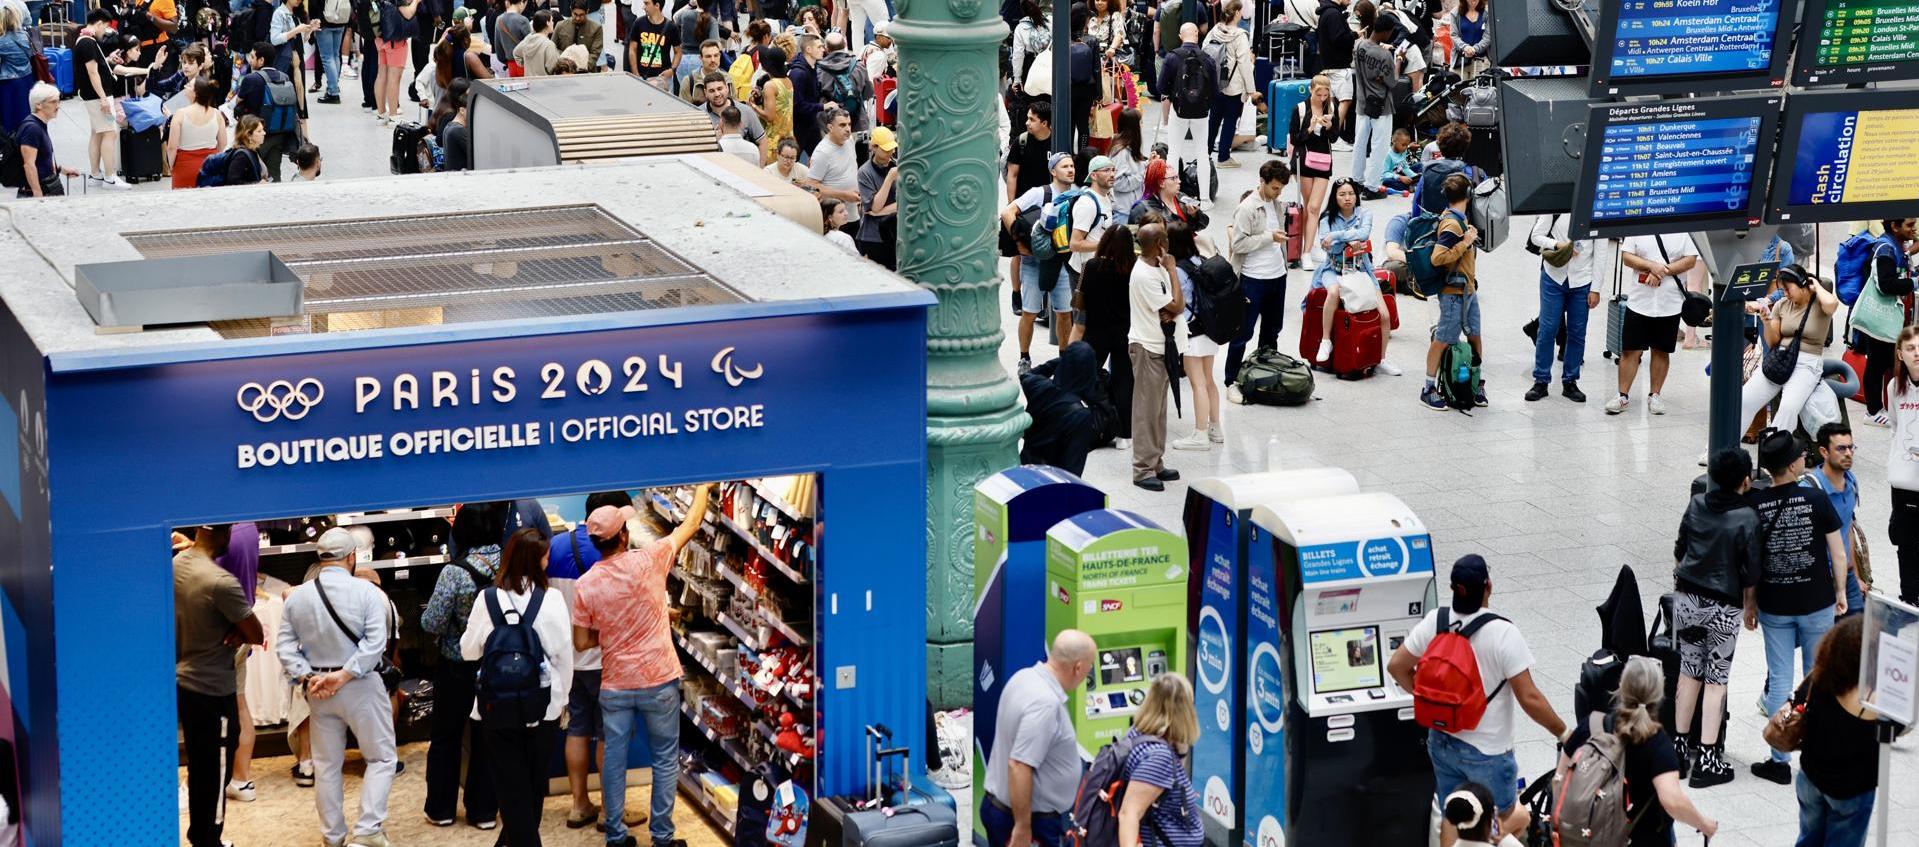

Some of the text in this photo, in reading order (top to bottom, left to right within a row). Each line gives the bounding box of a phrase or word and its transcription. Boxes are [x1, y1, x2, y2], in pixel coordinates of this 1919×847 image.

[1877, 7, 1906, 15] Bruxelles
[1673, 17, 1722, 26] Amsterdam
[1724, 15, 1760, 24] Centraal
[1875, 16, 1904, 25] Bruxelles
[1686, 26, 1716, 34] Bruxelles
[1718, 25, 1734, 33] Midi
[1873, 26, 1898, 34] London
[1648, 38, 1668, 46] 10h24
[1670, 35, 1719, 45] Amsterdam
[1721, 33, 1757, 42] Centraal
[1871, 35, 1891, 43] Calais
[1892, 33, 1907, 41] Ville
[1647, 46, 1684, 56] Antwerpen
[1685, 44, 1714, 53] Centraal
[1870, 43, 1899, 52] Bruxelles
[1900, 41, 1915, 50] Midi
[1667, 55, 1692, 63] Calais
[1694, 53, 1713, 62] Ville
[1868, 52, 1905, 61] Amsterdam
[1609, 103, 1695, 117] Départs Grandes Lignes
[1660, 123, 1696, 133] Dunkerque
[1658, 132, 1702, 142] Valenciennes
[1656, 142, 1685, 150] Beauvais
[1655, 147, 1733, 160] Saint-Just-en-Chaussée
[1653, 157, 1704, 170] Enregistrement
[1705, 156, 1727, 165] ouvert
[1828, 115, 1856, 204] circulation
[1651, 170, 1677, 178] Amiens
[1724, 130, 1751, 210] départs
[1650, 180, 1667, 188] Laon
[1811, 164, 1831, 205] flash
[1649, 188, 1679, 197] Bruxelles
[1680, 186, 1696, 195] Midi
[1667, 195, 1681, 204] Hbf
[1646, 206, 1675, 215] Beauvais
[1758, 271, 1768, 281] P
[540, 354, 684, 400] 2024
[237, 404, 764, 470] BOUTIQUE OFFICIELLE OFFICIAL STORE
[1368, 545, 1387, 554] achat
[1302, 550, 1336, 561] BILLETS
[1369, 553, 1391, 562] retrait
[1082, 554, 1171, 571] HAUTS-DE-FRANCE
[1214, 553, 1230, 570] achat
[1303, 557, 1354, 570] Grandes Lignes
[1370, 560, 1398, 572] échange
[1082, 567, 1148, 581] NORTH OF FRANCE
[1212, 567, 1231, 585] retrait
[1206, 577, 1230, 601] échange
[1251, 576, 1268, 593] achat
[1101, 601, 1122, 611] SNCF
[1251, 604, 1276, 629] échange
[1201, 640, 1208, 662] 3
[1208, 654, 1223, 672] min
[1257, 676, 1265, 698] 3
[1265, 691, 1280, 711] min
